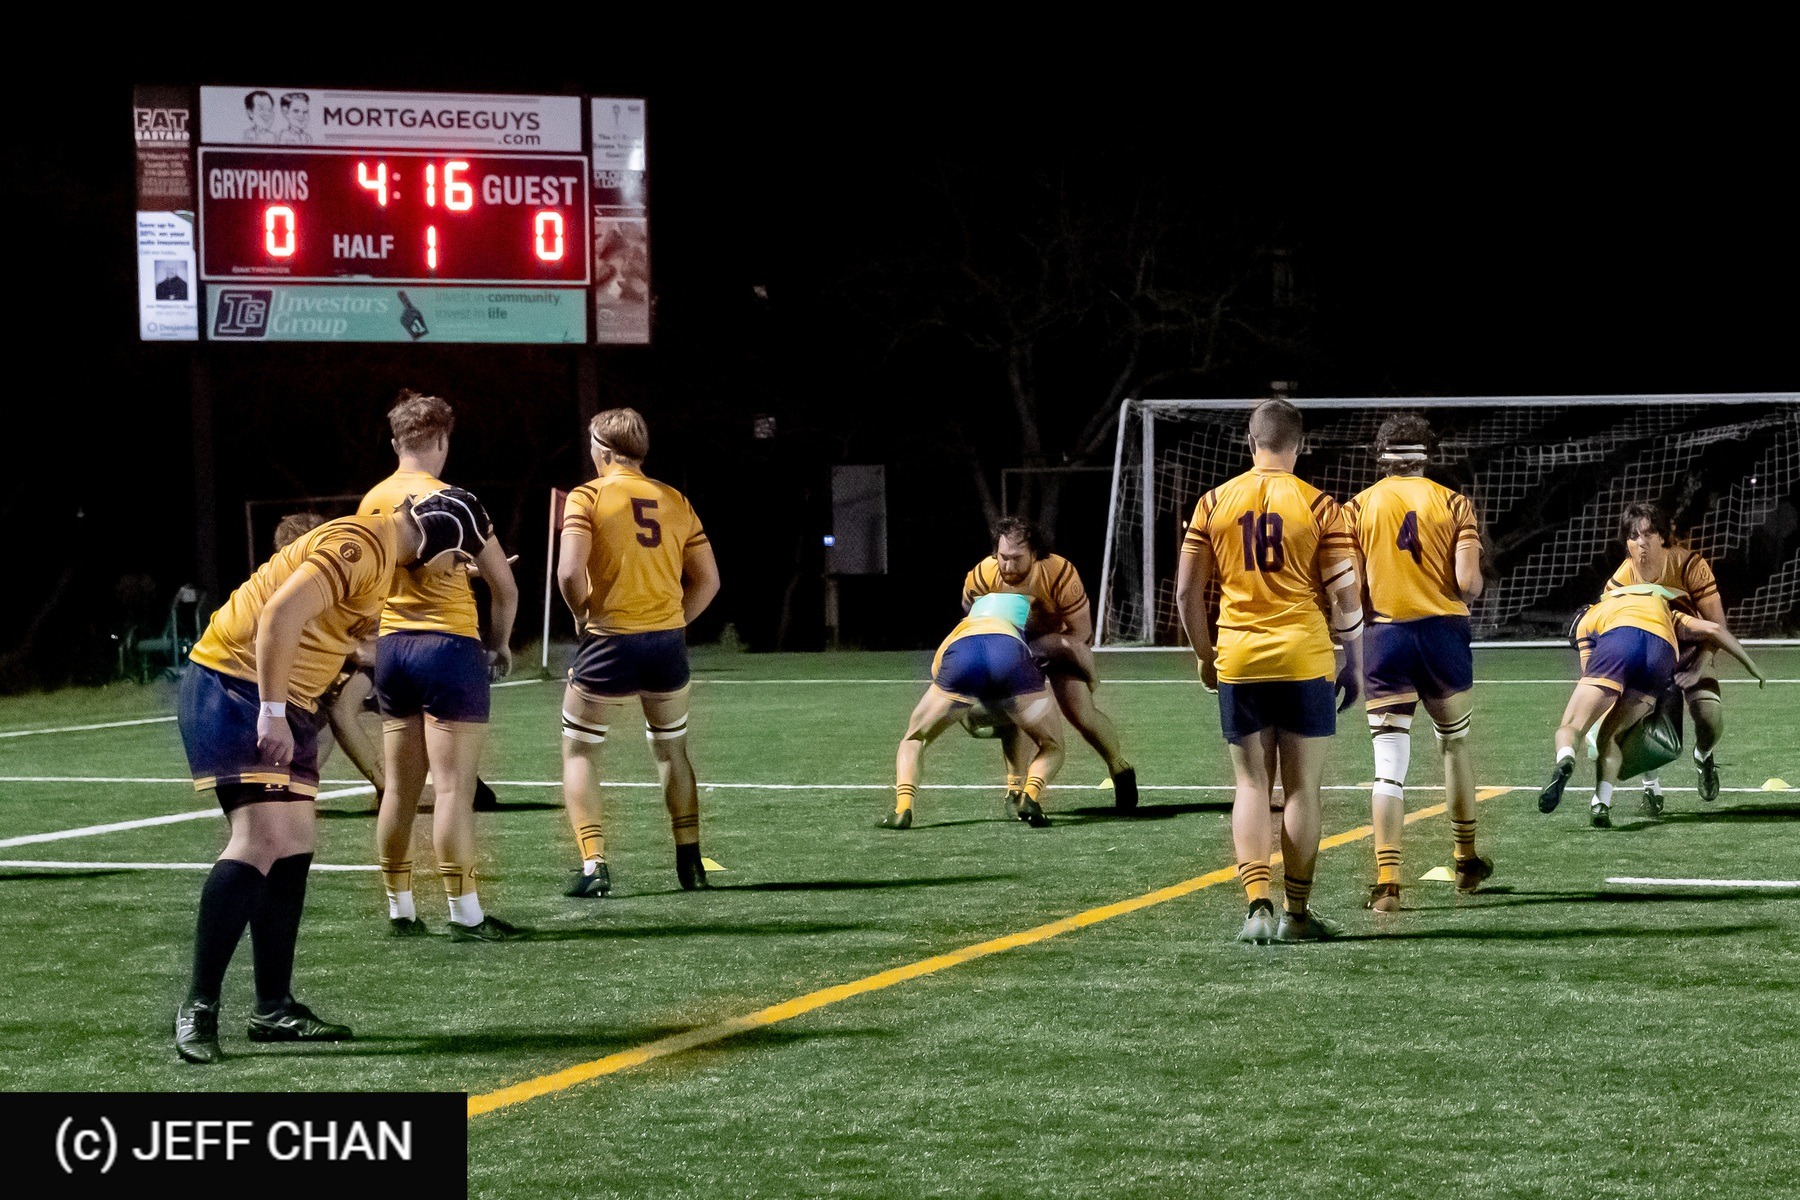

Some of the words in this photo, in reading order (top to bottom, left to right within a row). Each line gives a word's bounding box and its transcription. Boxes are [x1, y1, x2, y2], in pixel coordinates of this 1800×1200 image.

[134, 108, 189, 131] FAT
[323, 107, 540, 130] MORTGAGEGUYS
[135, 131, 190, 141] BASTARD
[498, 134, 541, 145] .com
[209, 168, 309, 200] GRYPHONS
[357, 161, 473, 211] 4:16
[482, 174, 578, 205] GUEST
[265, 206, 295, 257] 0
[535, 211, 564, 261] 0
[333, 233, 395, 260] HALF
[426, 225, 437, 269] 1
[277, 290, 390, 314] Investors
[487, 291, 561, 307] community
[272, 315, 348, 339] Group
[487, 308, 508, 320] life
[631, 497, 662, 549] 5
[1396, 510, 1423, 565] 4
[1238, 510, 1285, 573] 18
